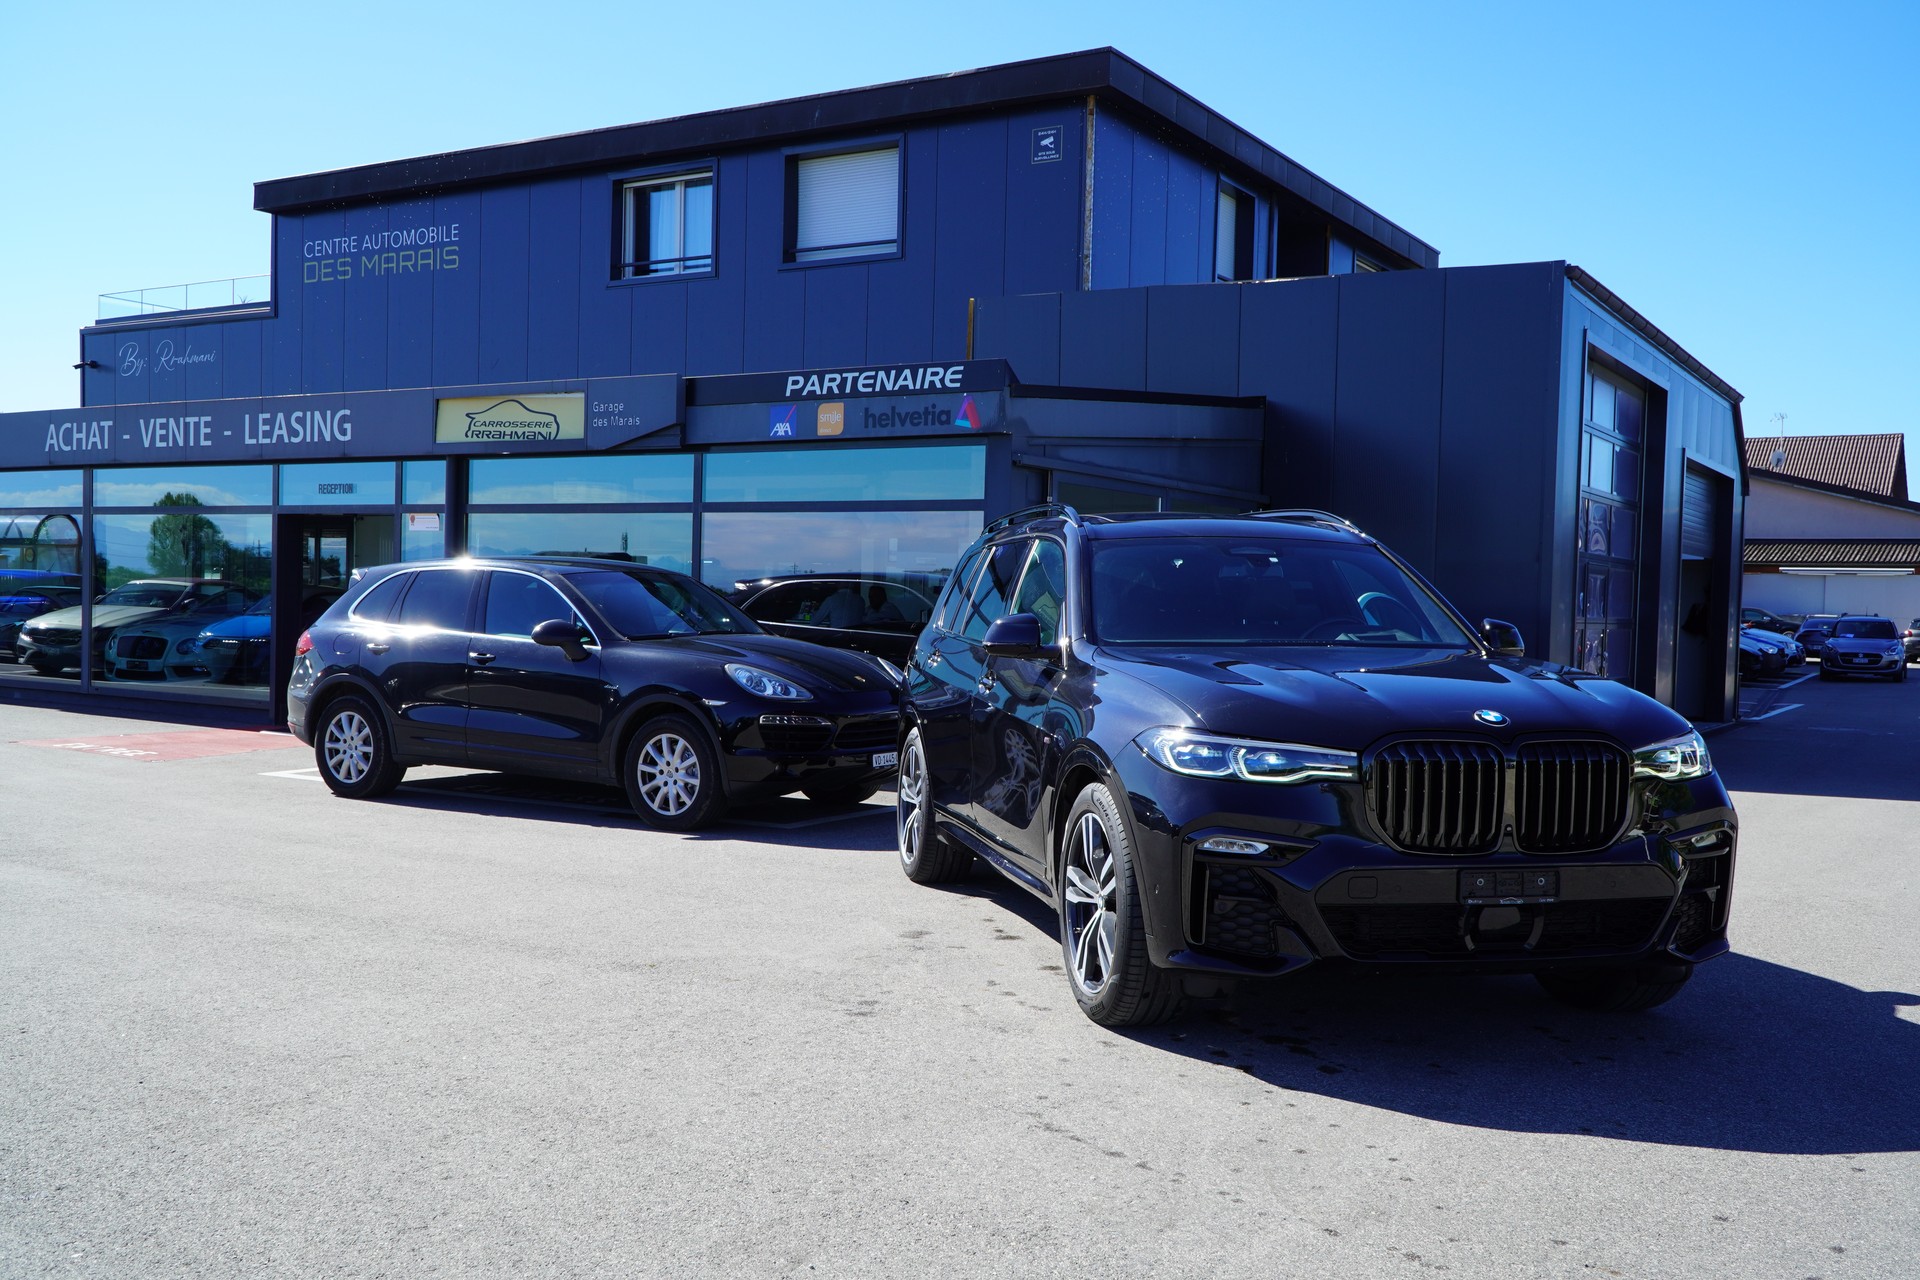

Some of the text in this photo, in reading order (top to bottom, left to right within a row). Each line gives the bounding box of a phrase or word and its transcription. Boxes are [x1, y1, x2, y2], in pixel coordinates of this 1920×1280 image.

[304, 224, 459, 258] CENTRE AUTOMOBILE
[304, 246, 459, 283] DES MARAIS
[785, 365, 964, 397] PARTENAIRE
[592, 401, 624, 412] Garage
[592, 414, 640, 427] des Marais
[820, 411, 841, 424] smile
[864, 402, 952, 429] helvetia
[45, 421, 113, 451] ACHAT
[139, 416, 212, 448] VENTE
[244, 409, 352, 445] LEASING
[473, 420, 553, 428] CARROSSERIE
[770, 422, 792, 436] AXA
[318, 483, 353, 494] RECEPTION
